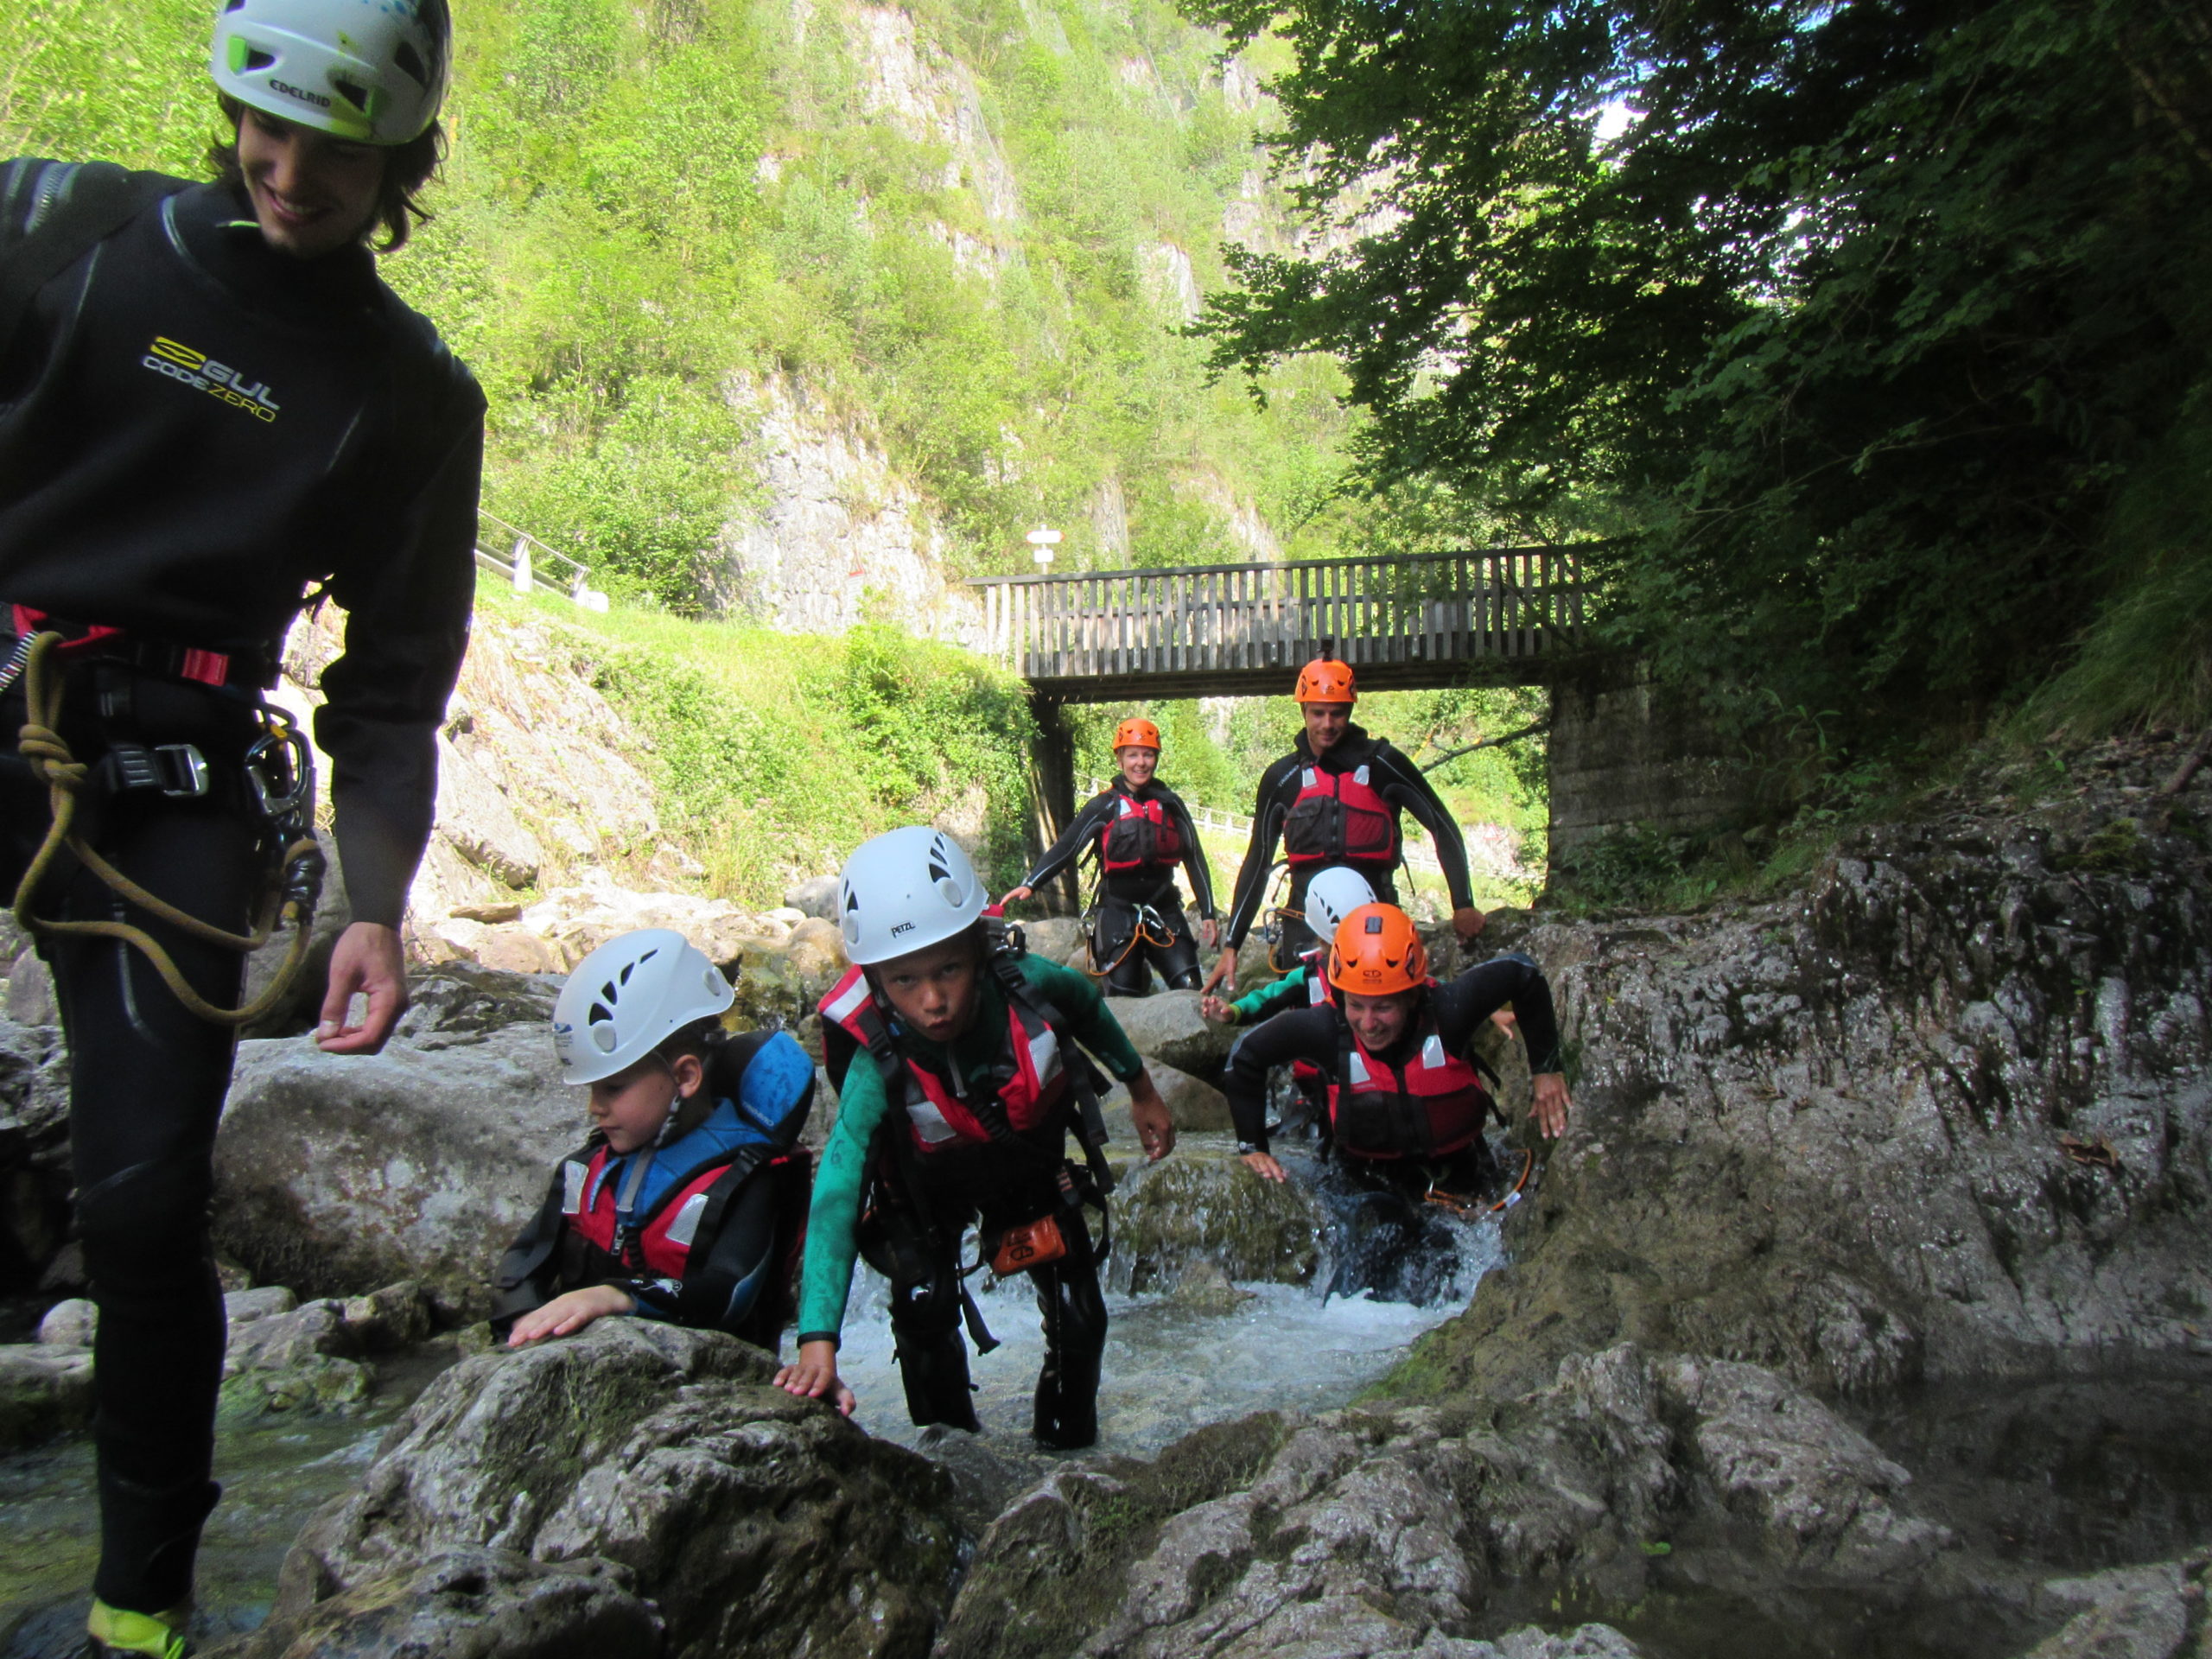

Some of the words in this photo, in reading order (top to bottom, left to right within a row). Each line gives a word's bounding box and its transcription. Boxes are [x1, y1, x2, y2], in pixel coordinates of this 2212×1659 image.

[270, 79, 330, 108] EDELRID
[201, 359, 281, 410] GUL
[891, 922, 916, 938] PETZL
